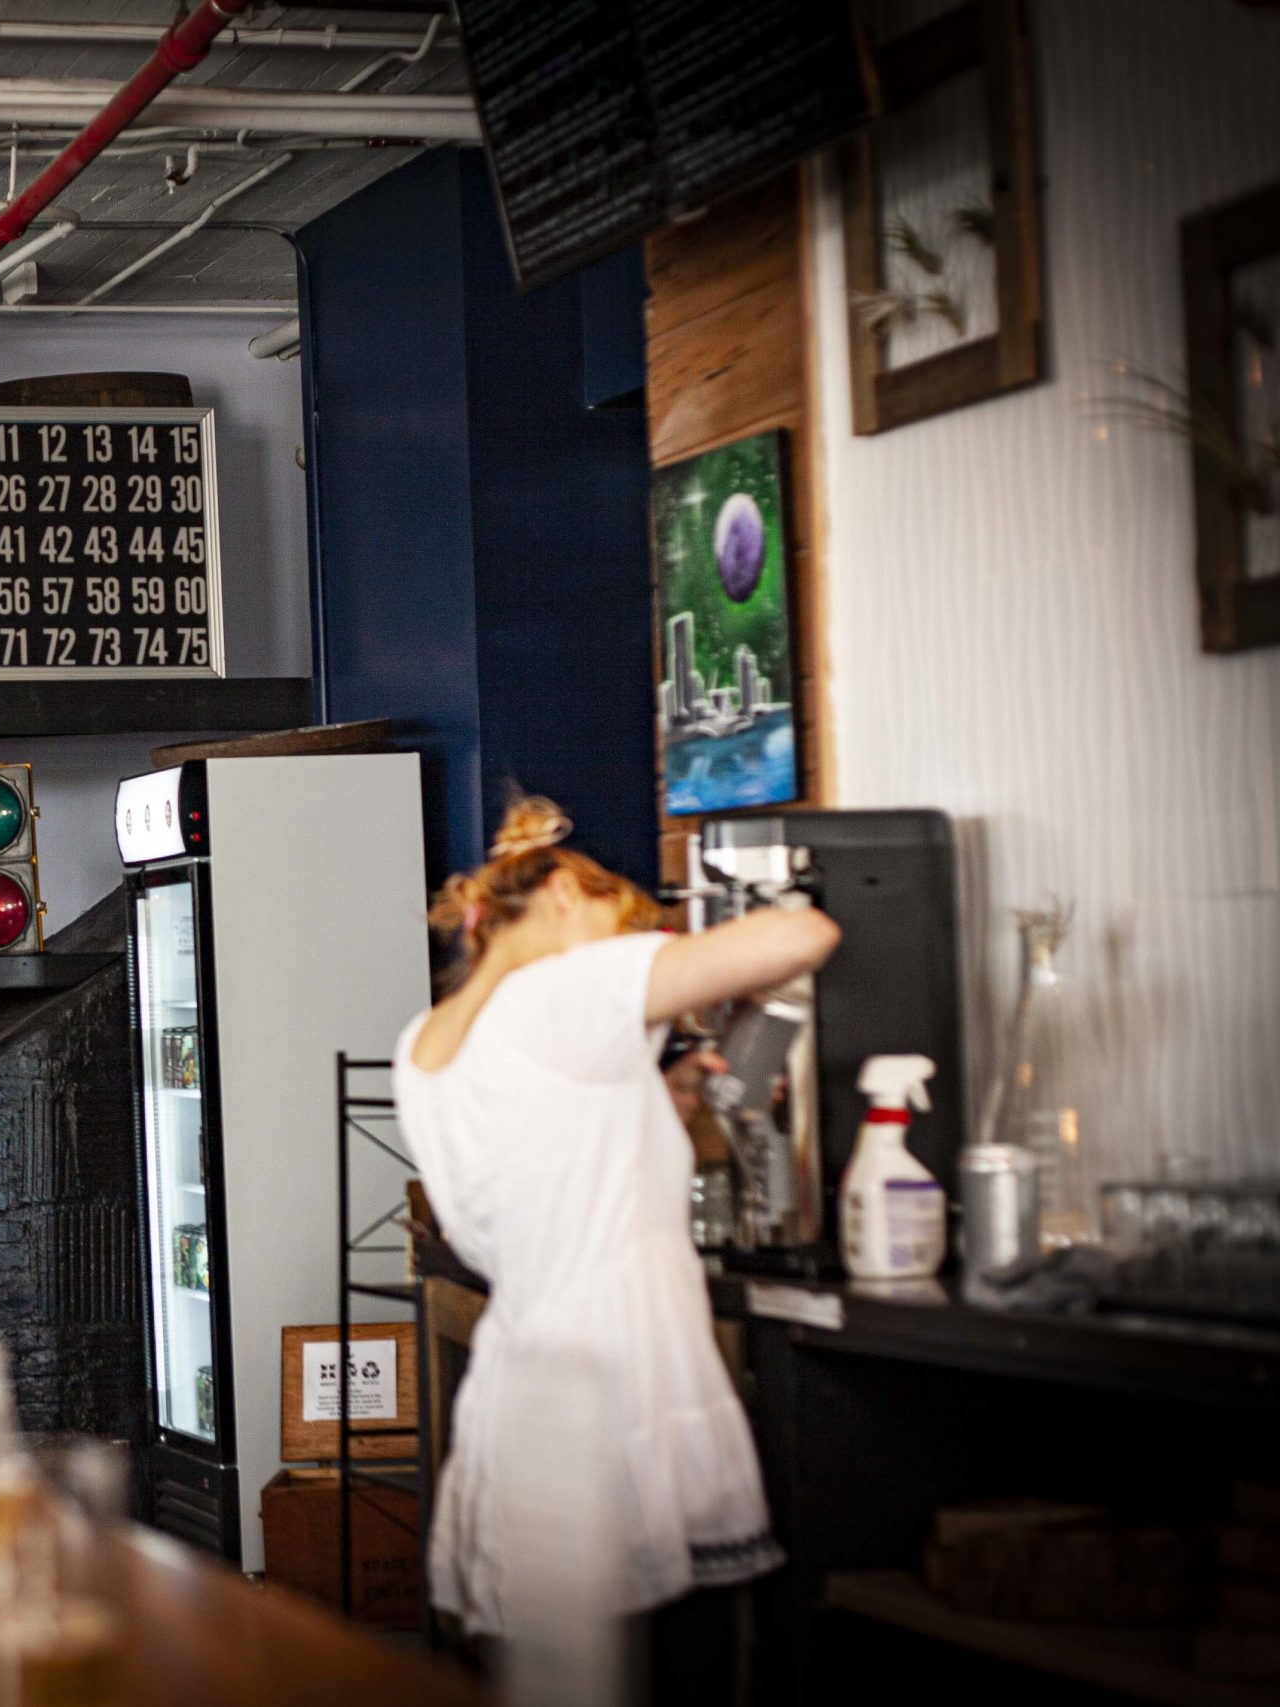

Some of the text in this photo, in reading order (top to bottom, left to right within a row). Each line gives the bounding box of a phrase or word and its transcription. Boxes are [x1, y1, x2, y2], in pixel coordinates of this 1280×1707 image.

[38, 424, 67, 462] 12
[83, 424, 113, 463] 13
[127, 426, 158, 463] 14
[169, 426, 198, 464] 15
[38, 475, 71, 512] 27
[82, 474, 117, 513] 28
[127, 474, 163, 513] 29
[170, 475, 202, 513] 30
[39, 525, 75, 563] 42
[83, 525, 119, 564] 43
[128, 526, 165, 563] 44
[172, 526, 205, 564] 45
[42, 577, 74, 615] 57
[86, 576, 121, 615] 58
[131, 576, 165, 615] 59
[174, 576, 207, 615] 60
[0, 628, 28, 666] 71
[42, 627, 76, 666] 72
[88, 627, 122, 666] 73
[133, 627, 169, 665] 74
[176, 627, 208, 665] 75
